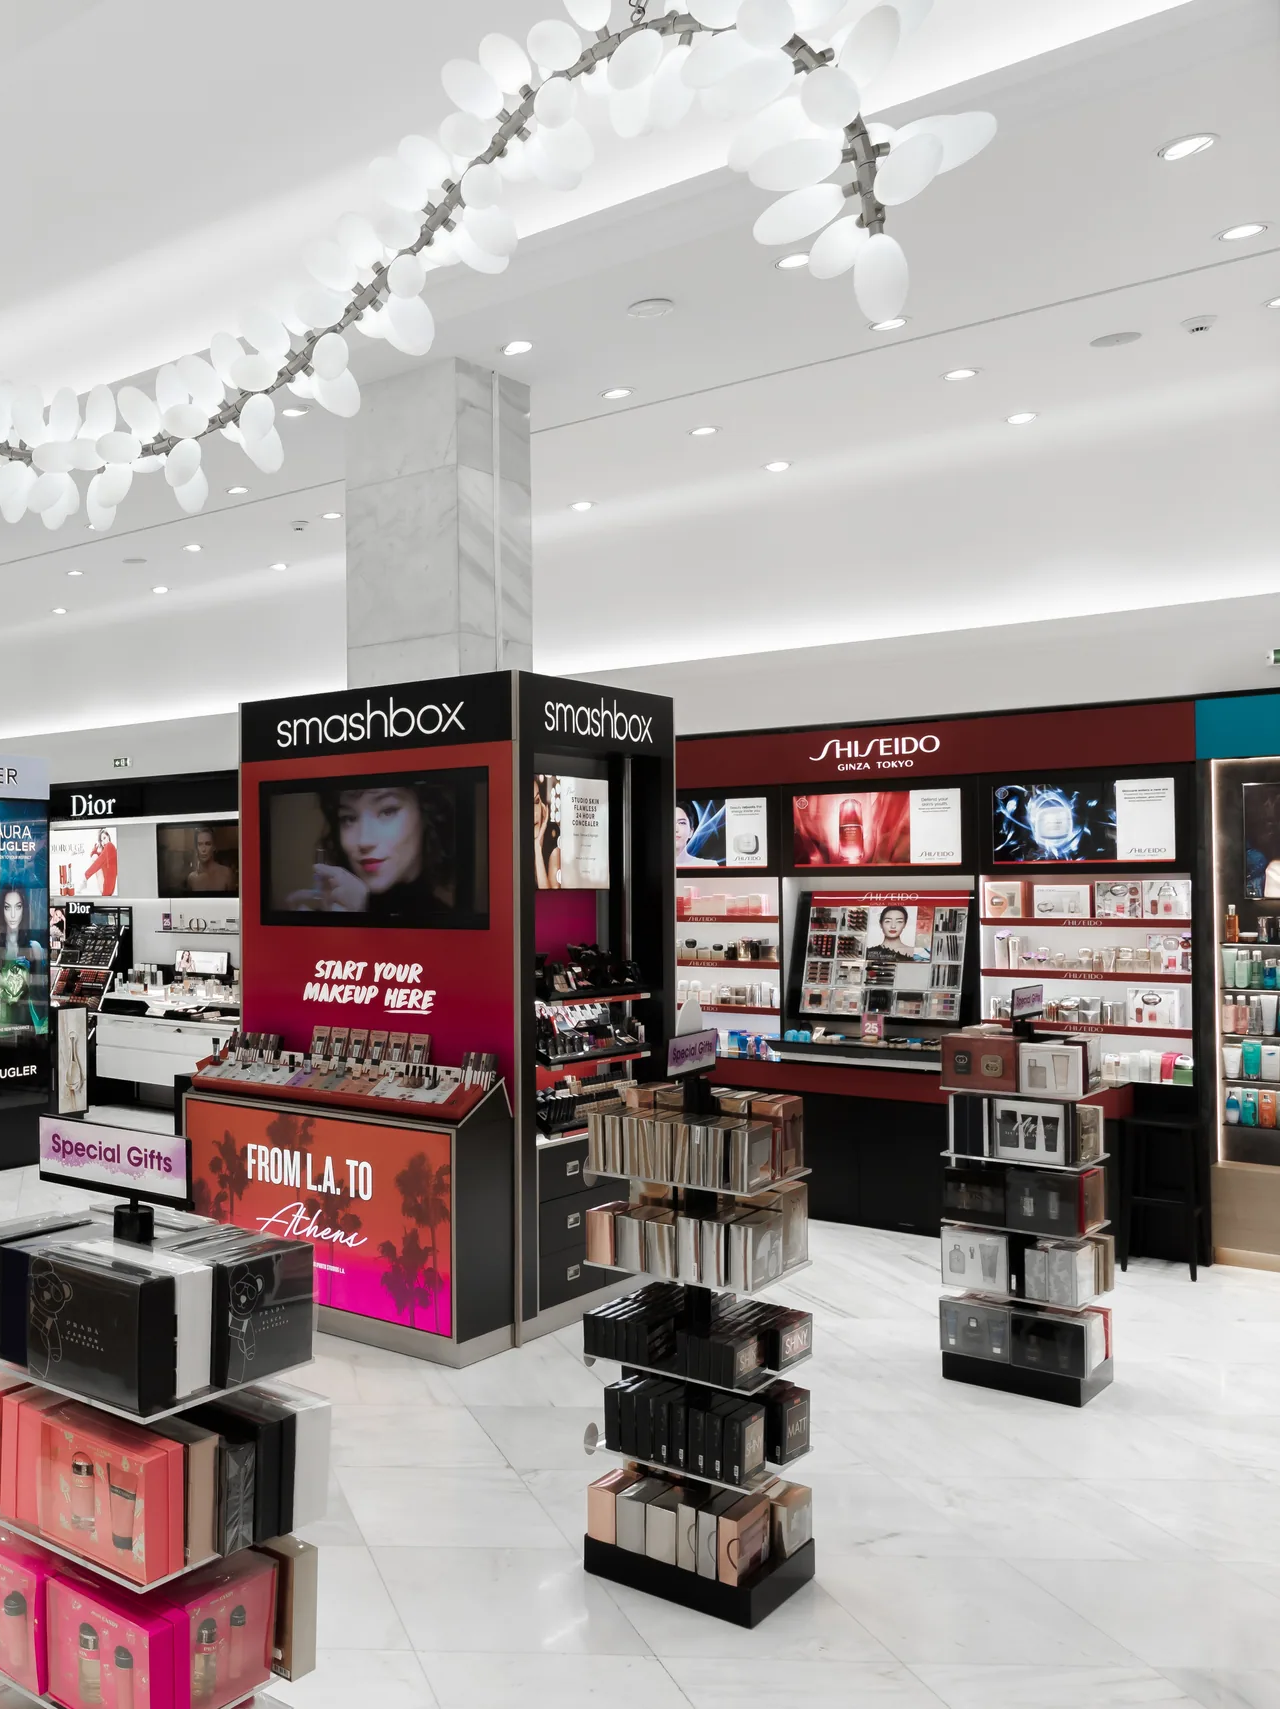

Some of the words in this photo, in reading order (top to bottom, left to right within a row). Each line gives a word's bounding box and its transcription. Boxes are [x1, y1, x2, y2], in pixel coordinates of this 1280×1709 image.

[276, 697, 466, 748] smashbox
[544, 697, 653, 744] smashbox
[809, 735, 940, 761] SHISEIDO
[837, 762, 871, 772] GINZA
[876, 759, 914, 769] TOKYO
[70, 794, 117, 817] Dior
[574, 804, 597, 812] FLAWLESS
[572, 819, 599, 827] CONCEALER
[69, 902, 91, 914] Dior
[857, 892, 919, 902] SHISEIDO
[314, 959, 368, 981] START
[373, 962, 423, 984] YOUR
[1062, 972, 1104, 980] SHISEIDO
[303, 982, 379, 1005] MAKEUP
[383, 987, 437, 1010] HERE
[864, 1022, 879, 1034] 25
[1062, 1024, 1104, 1033] SHISEIDO
[672, 1041, 697, 1063] Special
[697, 1040, 713, 1055] Gifts
[51, 1133, 121, 1163] Special
[127, 1146, 173, 1172] Gifts
[247, 1143, 300, 1188] FROM
[306, 1153, 341, 1195] L.A.
[345, 1159, 373, 1201] TO
[256, 1202, 368, 1247] Athens
[66, 1320, 99, 1335] PRADA
[67, 1330, 98, 1344] CARBON
[785, 1328, 809, 1355] SHINY
[786, 1417, 808, 1439] MATT
[745, 1435, 762, 1457] SHINY
